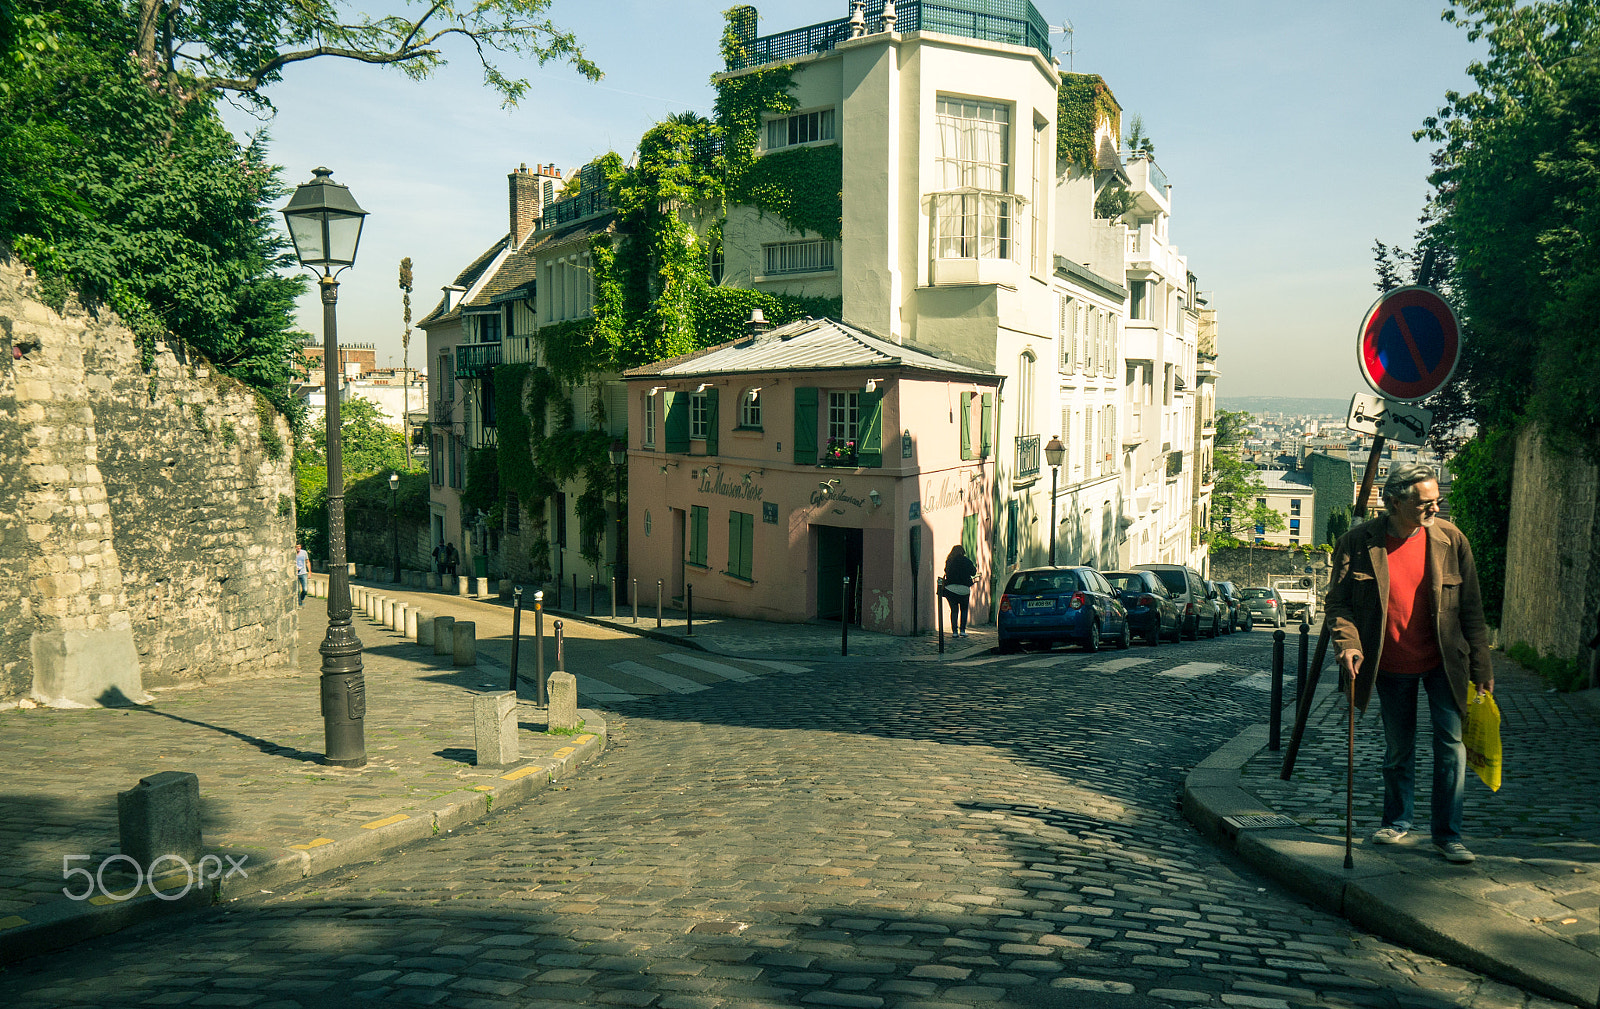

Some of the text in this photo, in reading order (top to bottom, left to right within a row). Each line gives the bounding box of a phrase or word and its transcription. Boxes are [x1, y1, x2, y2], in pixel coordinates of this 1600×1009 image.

[698, 471, 763, 501] La Maison Rose
